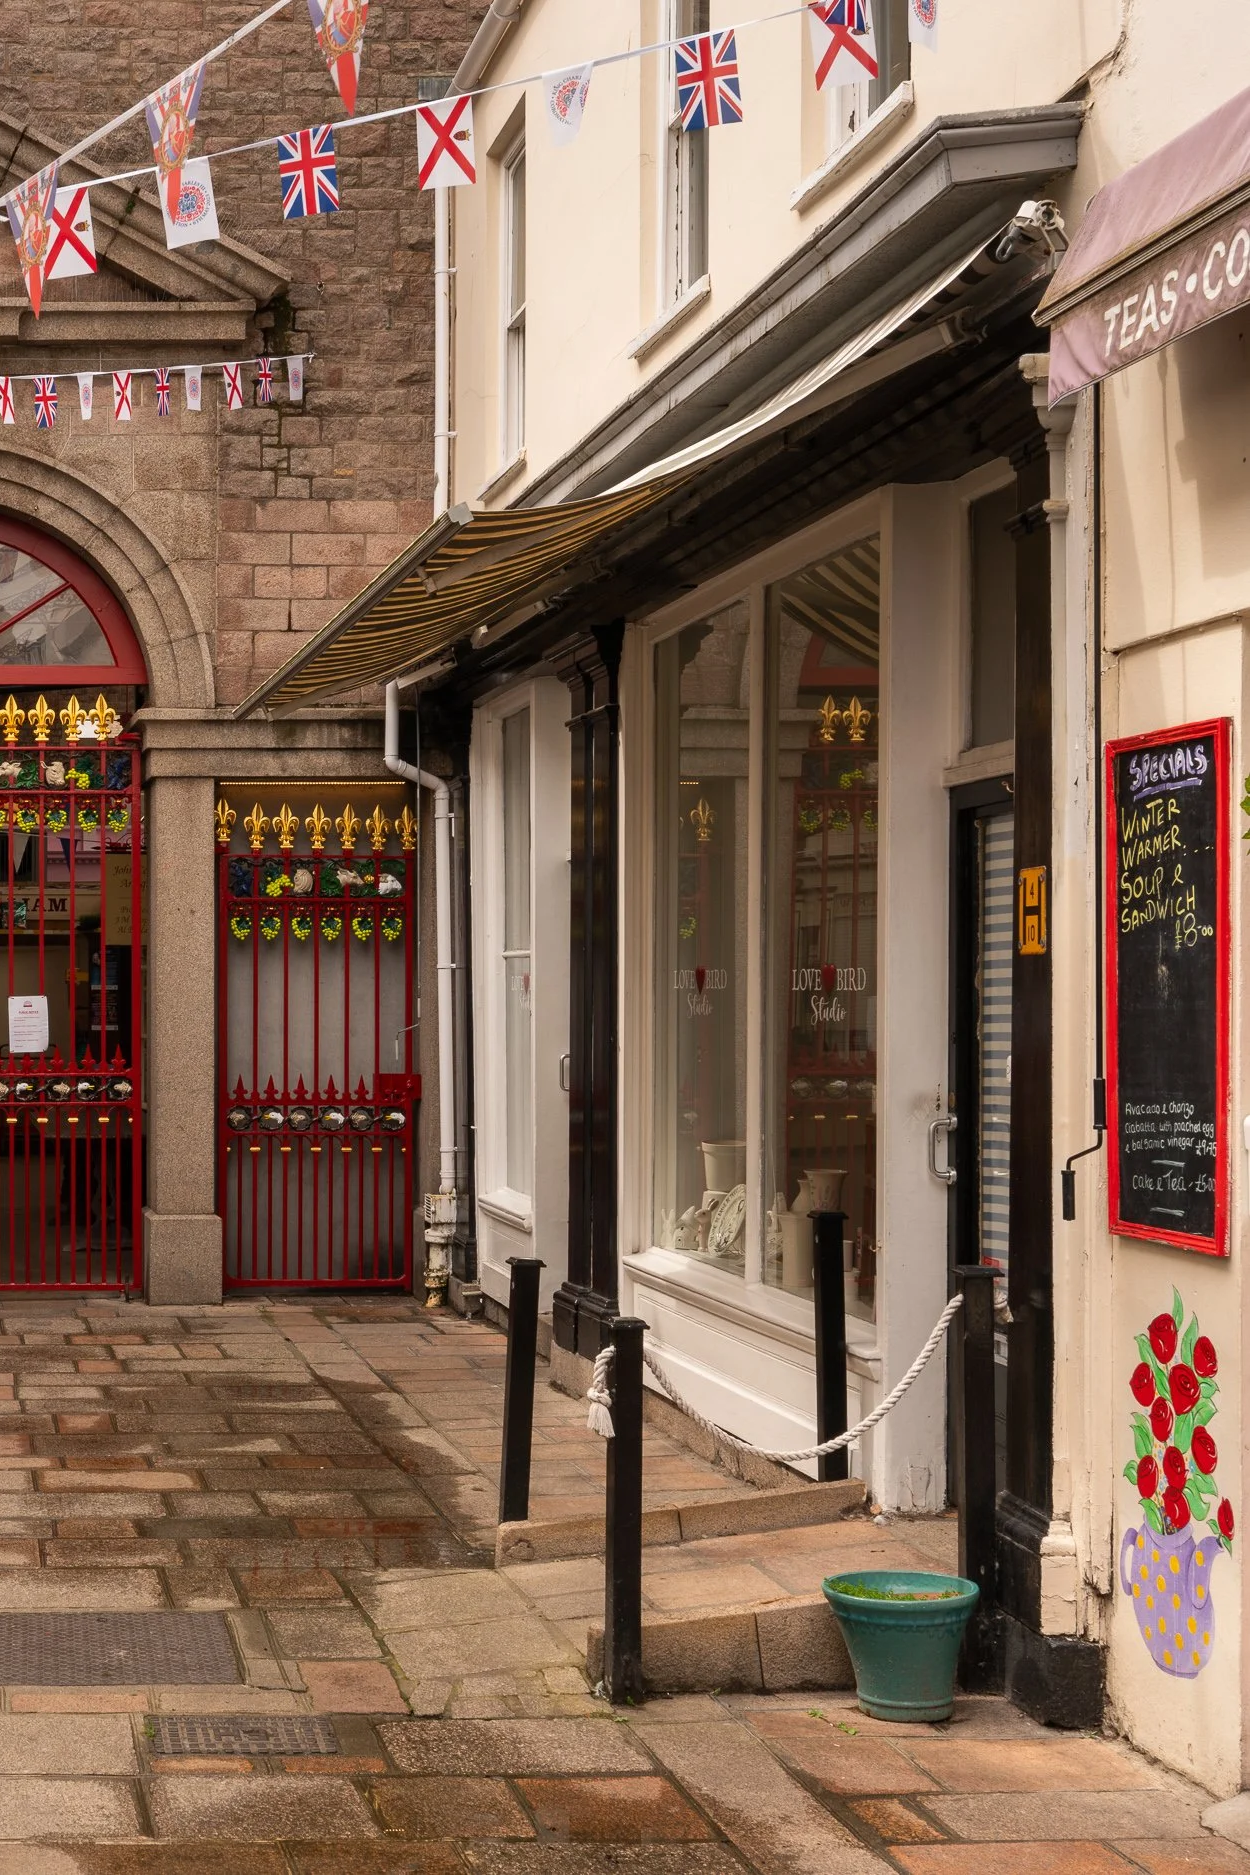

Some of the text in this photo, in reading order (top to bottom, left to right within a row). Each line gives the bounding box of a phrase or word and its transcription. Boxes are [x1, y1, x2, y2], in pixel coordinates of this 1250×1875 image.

[1103, 269, 1179, 358] TEAS
[1128, 745, 1209, 791] SPECIALS
[1121, 798, 1181, 843] WINTER
[1029, 882, 1035, 900] 4
[1121, 866, 1164, 905] SOUP
[1121, 885, 1196, 933] SANDWICH
[1027, 924, 1036, 942] 10
[673, 969, 728, 989] LOVE BIRD
[791, 967, 866, 992] LOVE BIRD
[687, 992, 714, 1019] Studio
[810, 994, 847, 1026] Studio
[1167, 1136, 1195, 1150] vinegar
[1202, 1123, 1215, 1139] egg
[1163, 1169, 1187, 1191] Tea
